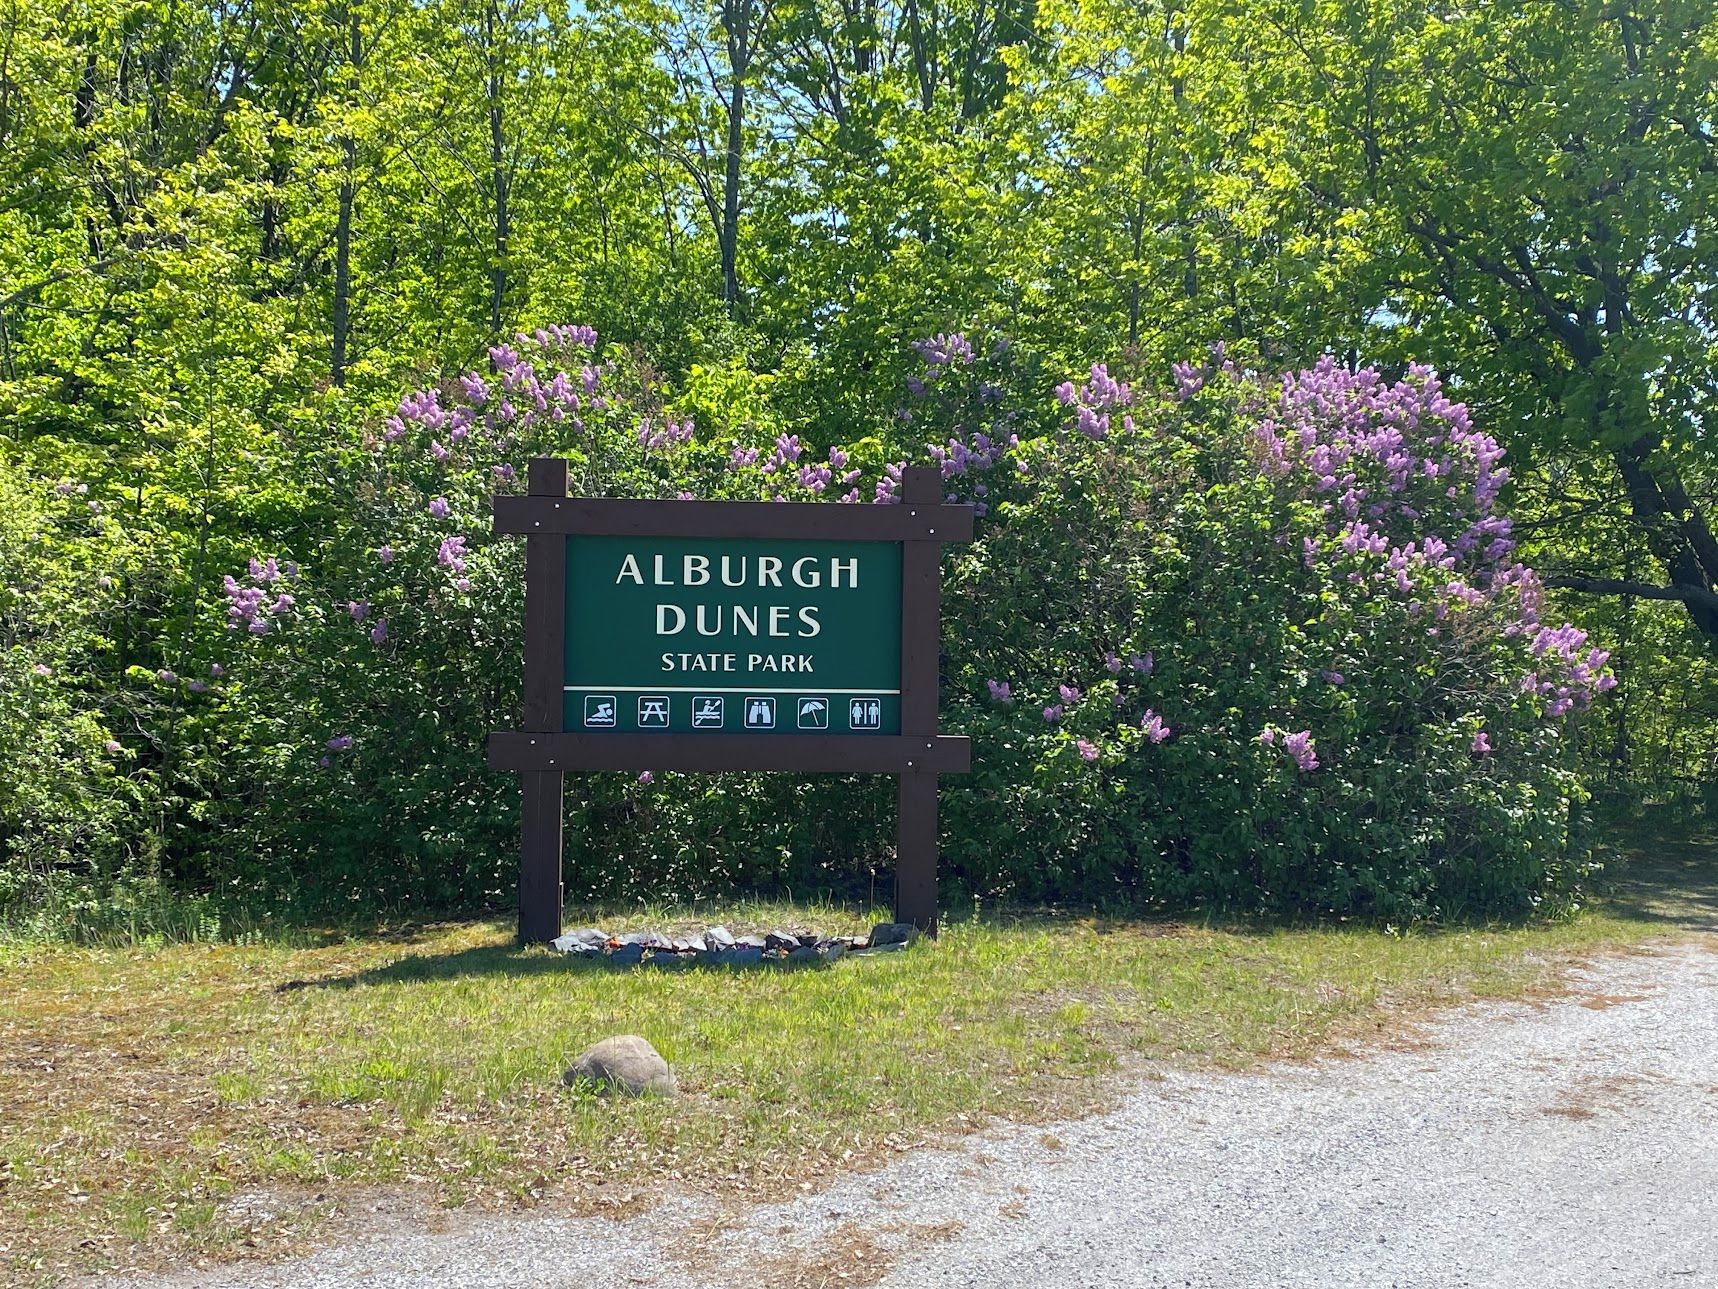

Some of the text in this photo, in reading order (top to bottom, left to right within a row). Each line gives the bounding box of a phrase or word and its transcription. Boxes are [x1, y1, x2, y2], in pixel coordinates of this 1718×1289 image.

[615, 554, 859, 588] ALBURGH
[656, 604, 822, 637] DUNES
[661, 653, 814, 673] STATE PARK
